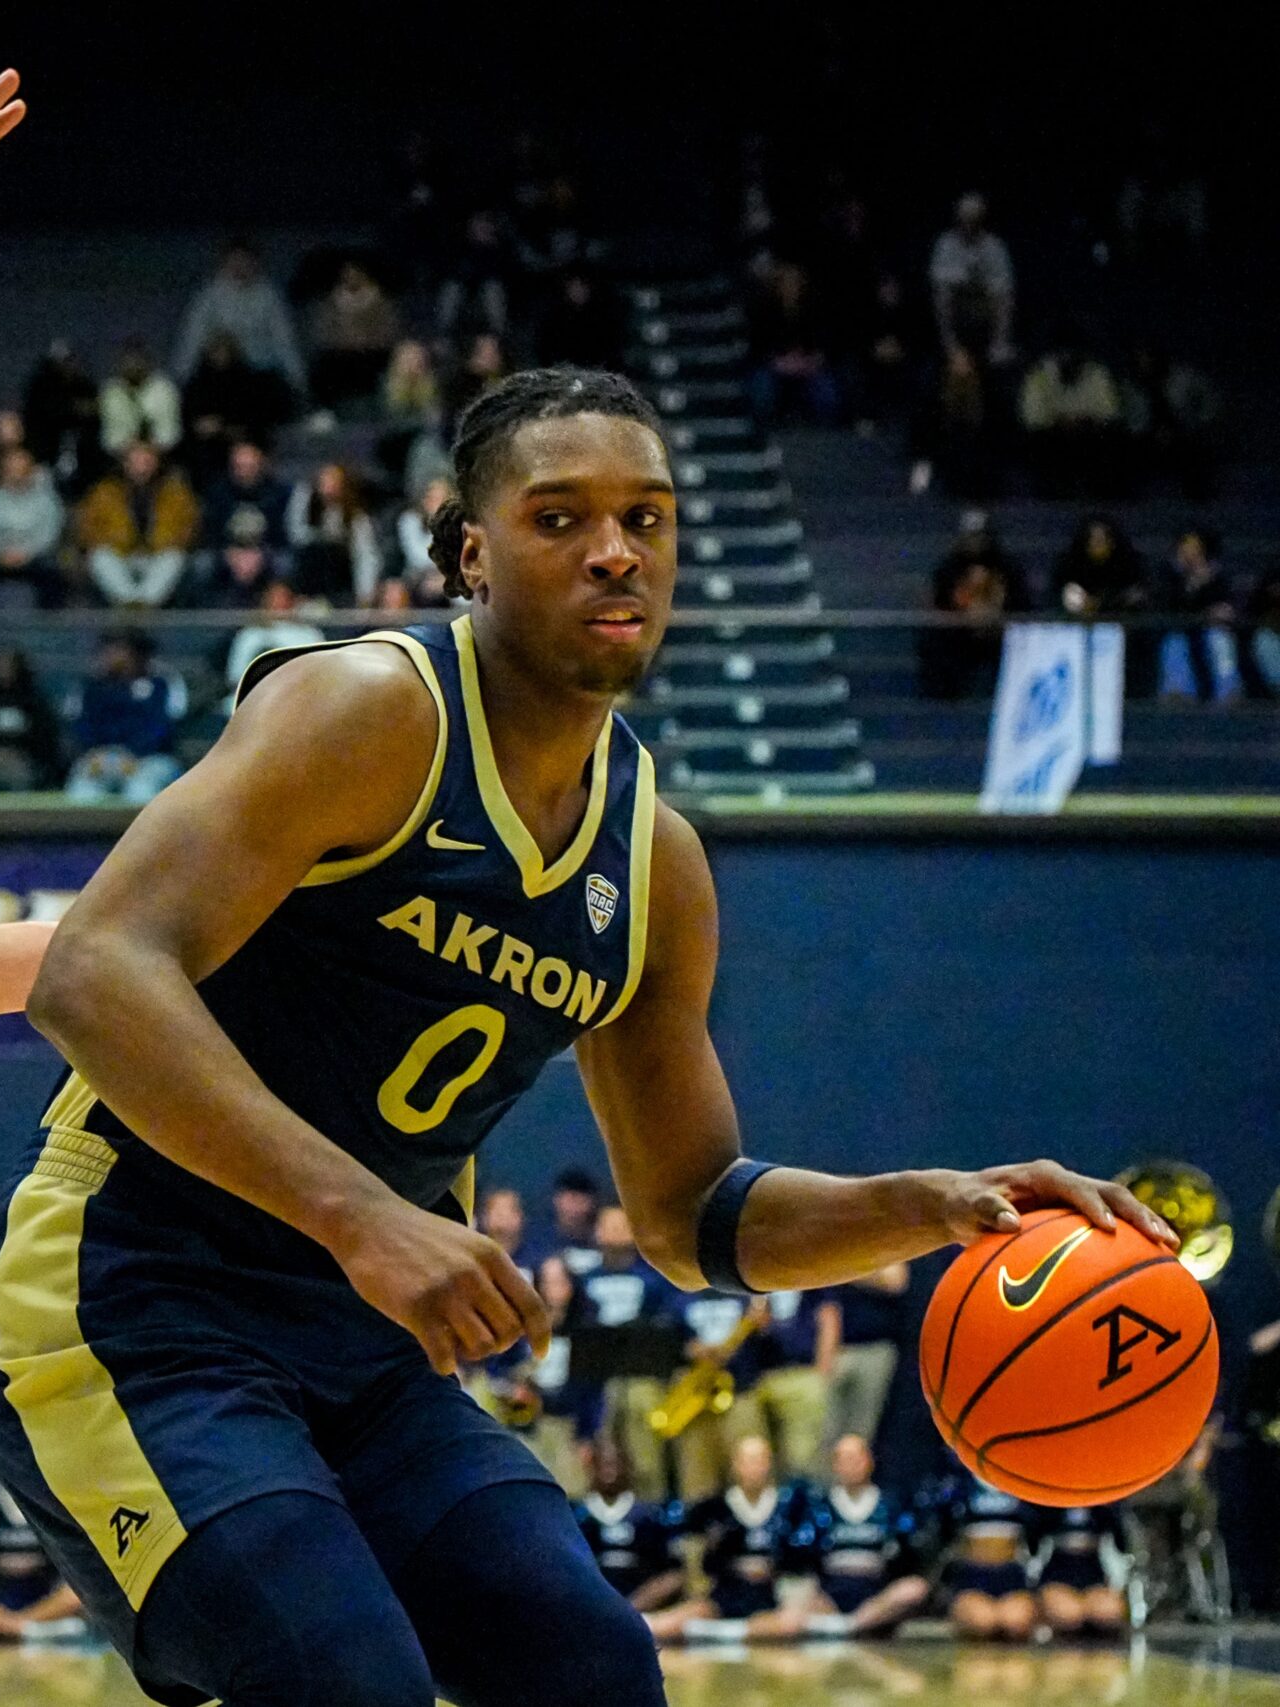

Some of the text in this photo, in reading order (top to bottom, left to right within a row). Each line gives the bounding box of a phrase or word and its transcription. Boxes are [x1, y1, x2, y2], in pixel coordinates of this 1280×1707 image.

[589, 889, 614, 914] MAC
[377, 895, 607, 1024] AKRON
[377, 1003, 506, 1134] 0
[1091, 1303, 1182, 1391] A
[109, 1506, 150, 1559] A
